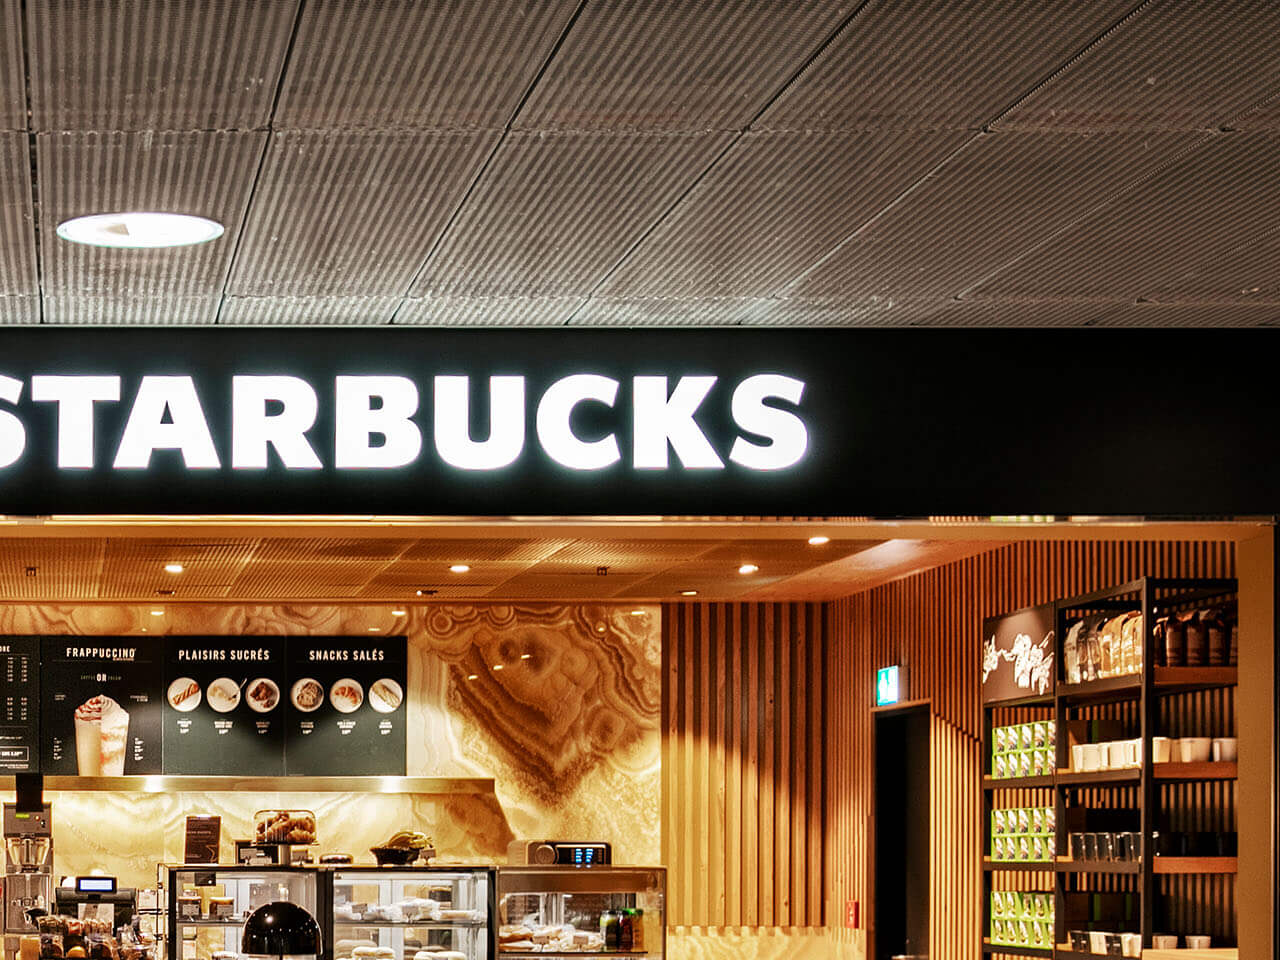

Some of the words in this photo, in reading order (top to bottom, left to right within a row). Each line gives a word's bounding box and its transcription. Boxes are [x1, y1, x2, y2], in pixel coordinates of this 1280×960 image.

[65, 647, 135, 658] FRAPPUCCINO
[178, 649, 226, 661] PLAISIRS
[230, 647, 270, 661] SUCRÉS
[309, 650, 349, 661] SNACKS
[353, 648, 385, 661] SALÉS
